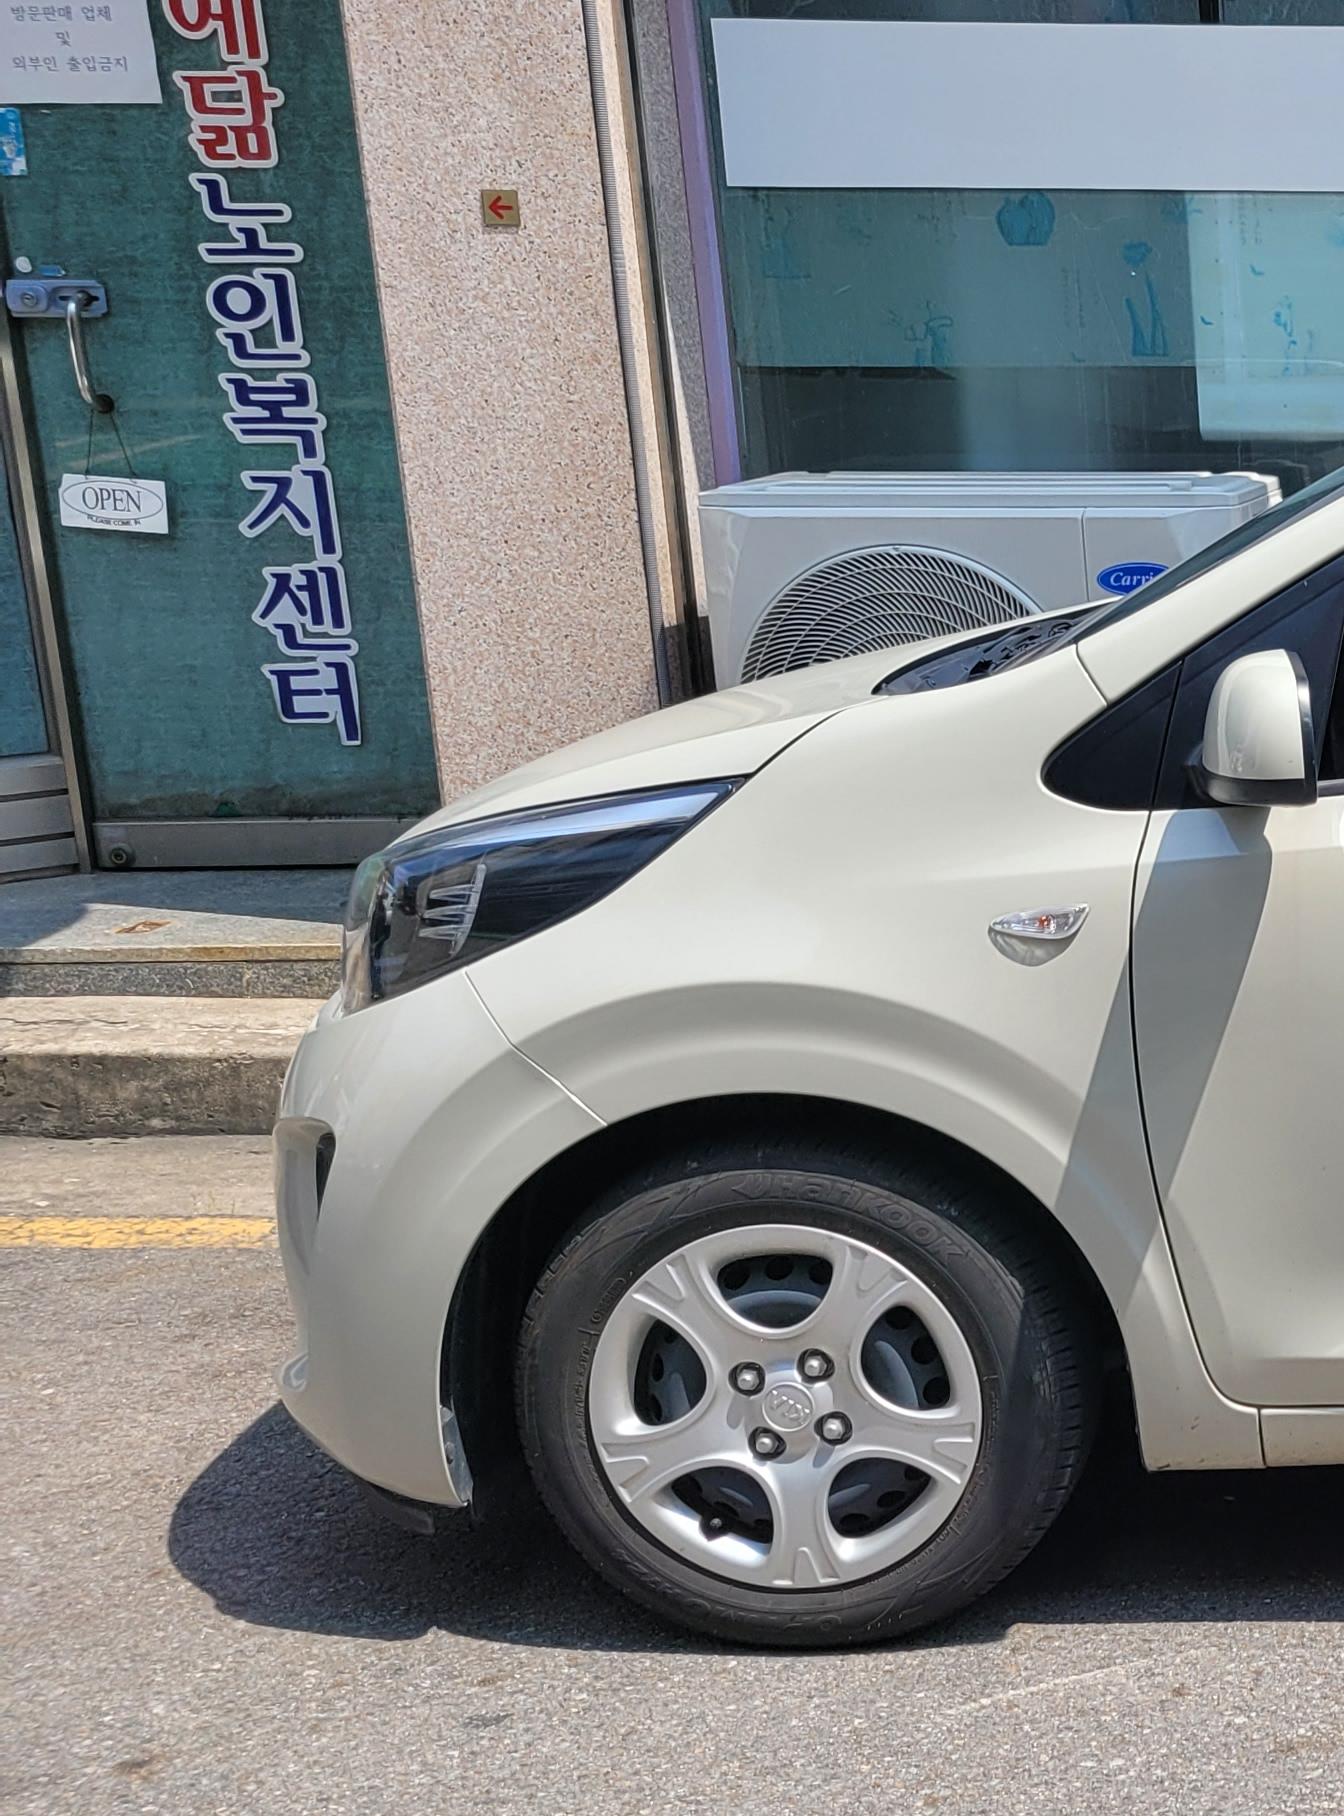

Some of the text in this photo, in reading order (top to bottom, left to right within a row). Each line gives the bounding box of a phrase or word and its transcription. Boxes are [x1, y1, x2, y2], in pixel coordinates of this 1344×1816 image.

[10, 4, 113, 22] 방문판매 업체
[55, 31, 71, 47] 및
[12, 55, 129, 72] 외부인 출입금지
[82, 486, 143, 513] OPEN
[1110, 571, 1155, 587] Carri
